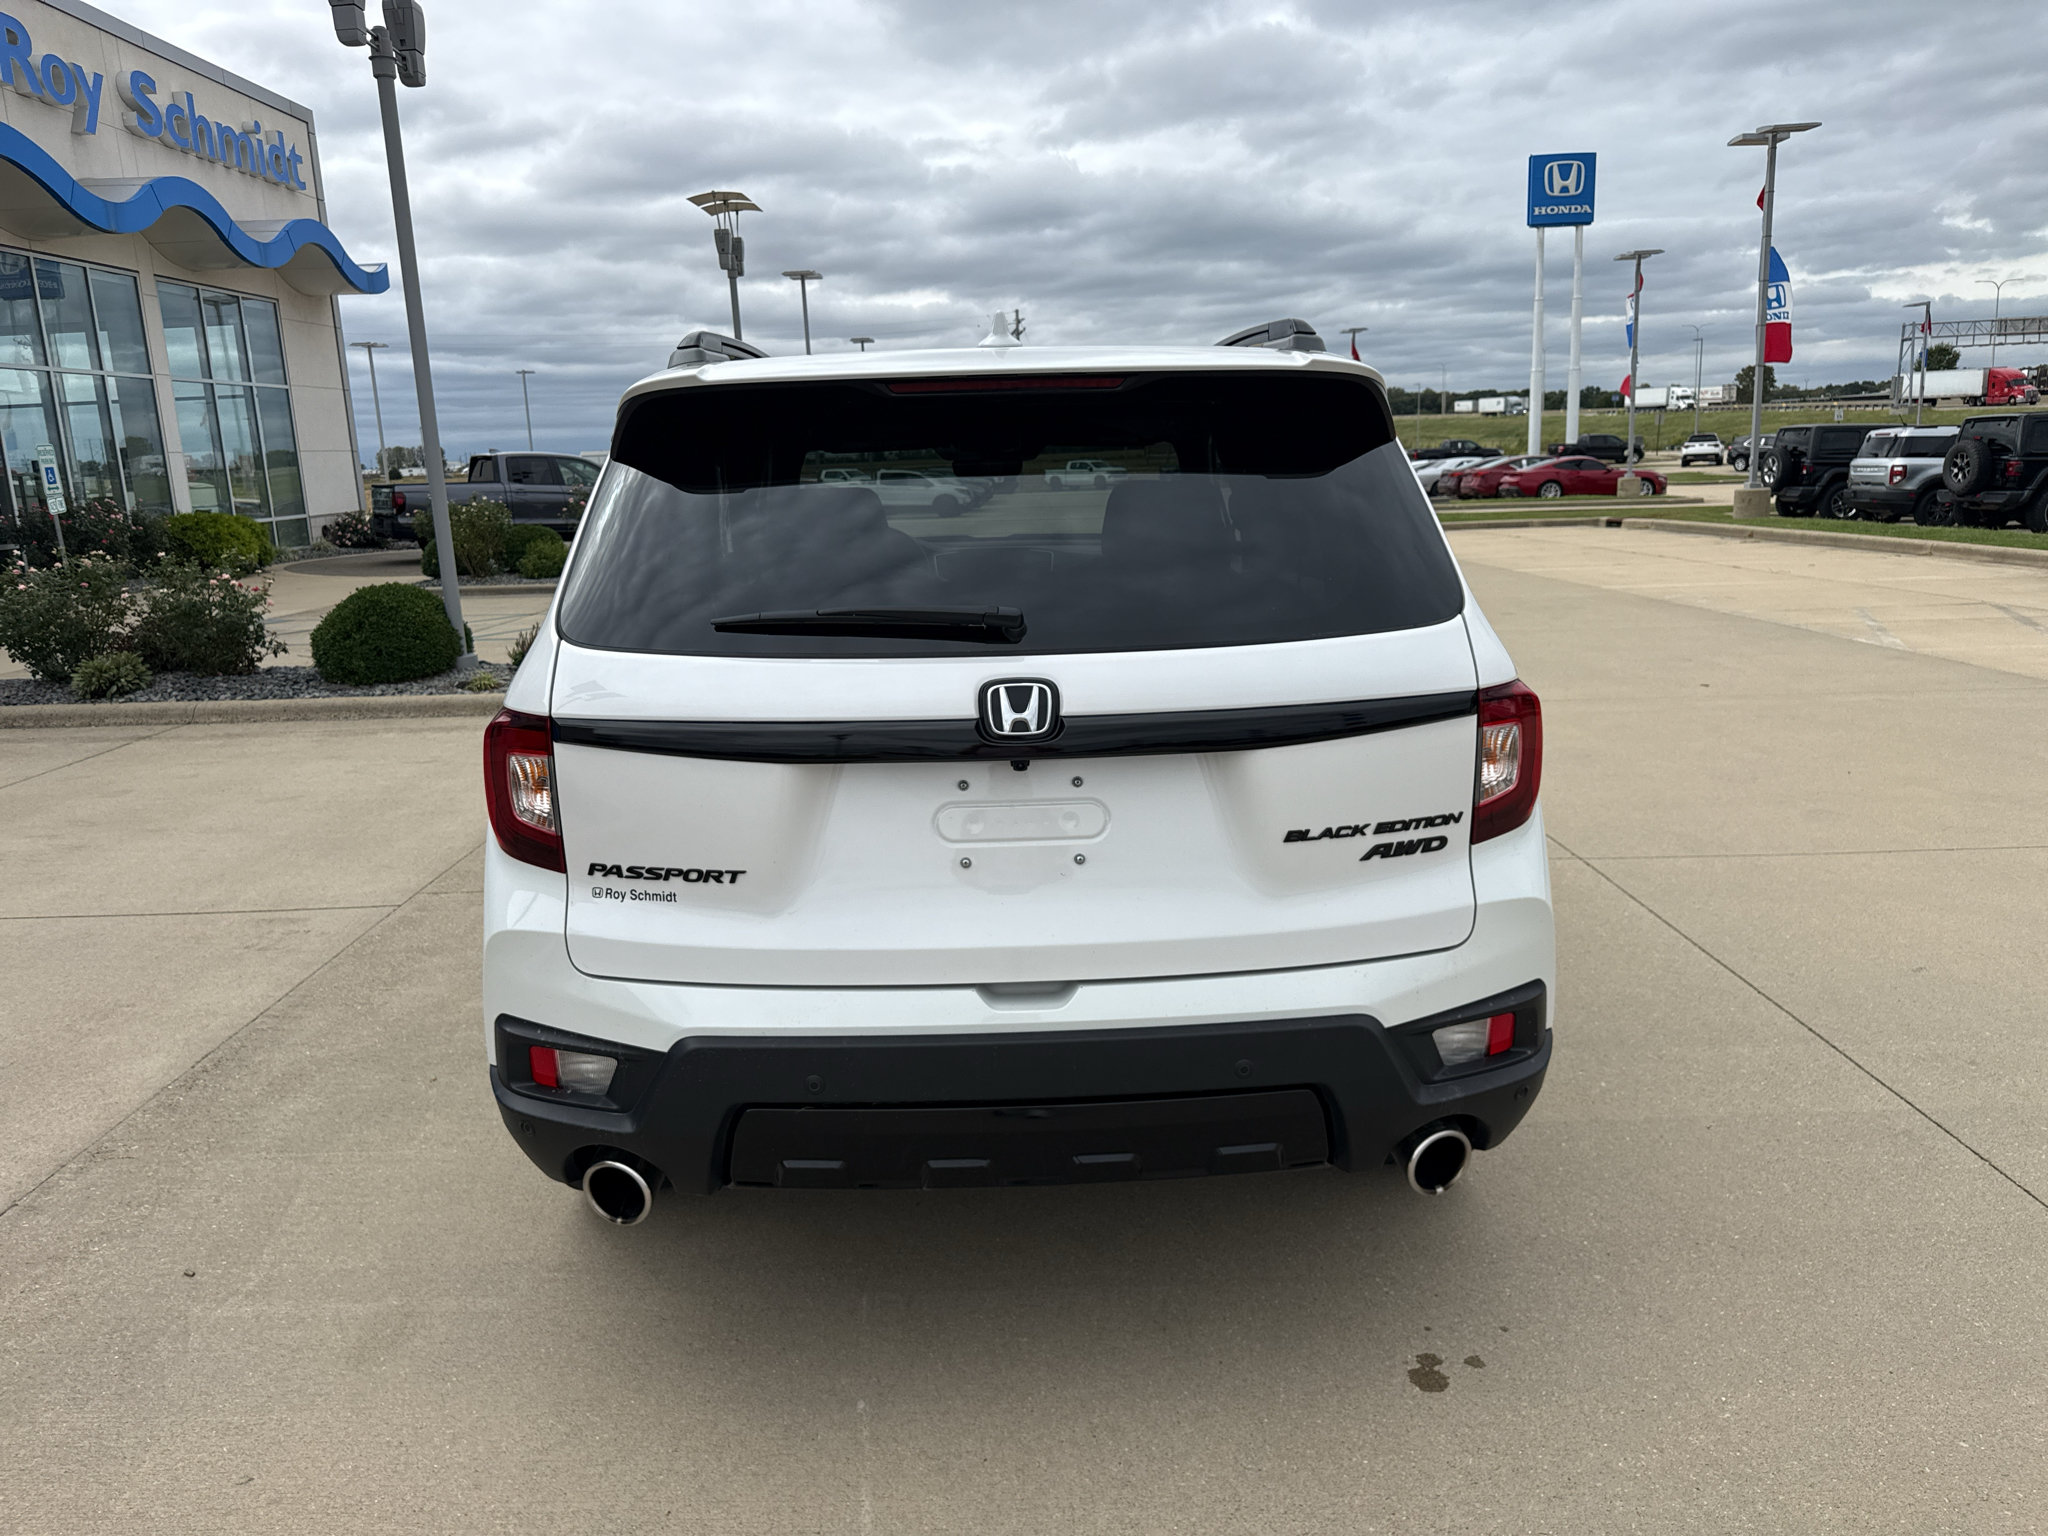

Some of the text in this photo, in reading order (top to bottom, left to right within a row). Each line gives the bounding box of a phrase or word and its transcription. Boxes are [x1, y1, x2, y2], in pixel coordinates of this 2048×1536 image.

[0, 12, 307, 190] Roy Schmidt
[1533, 204, 1592, 216] HONDA
[1283, 811, 1464, 843] BLACK EDITION
[1359, 835, 1448, 861] AWD
[587, 862, 747, 884] PASSPORT
[605, 887, 678, 903] Roy Schmidt
